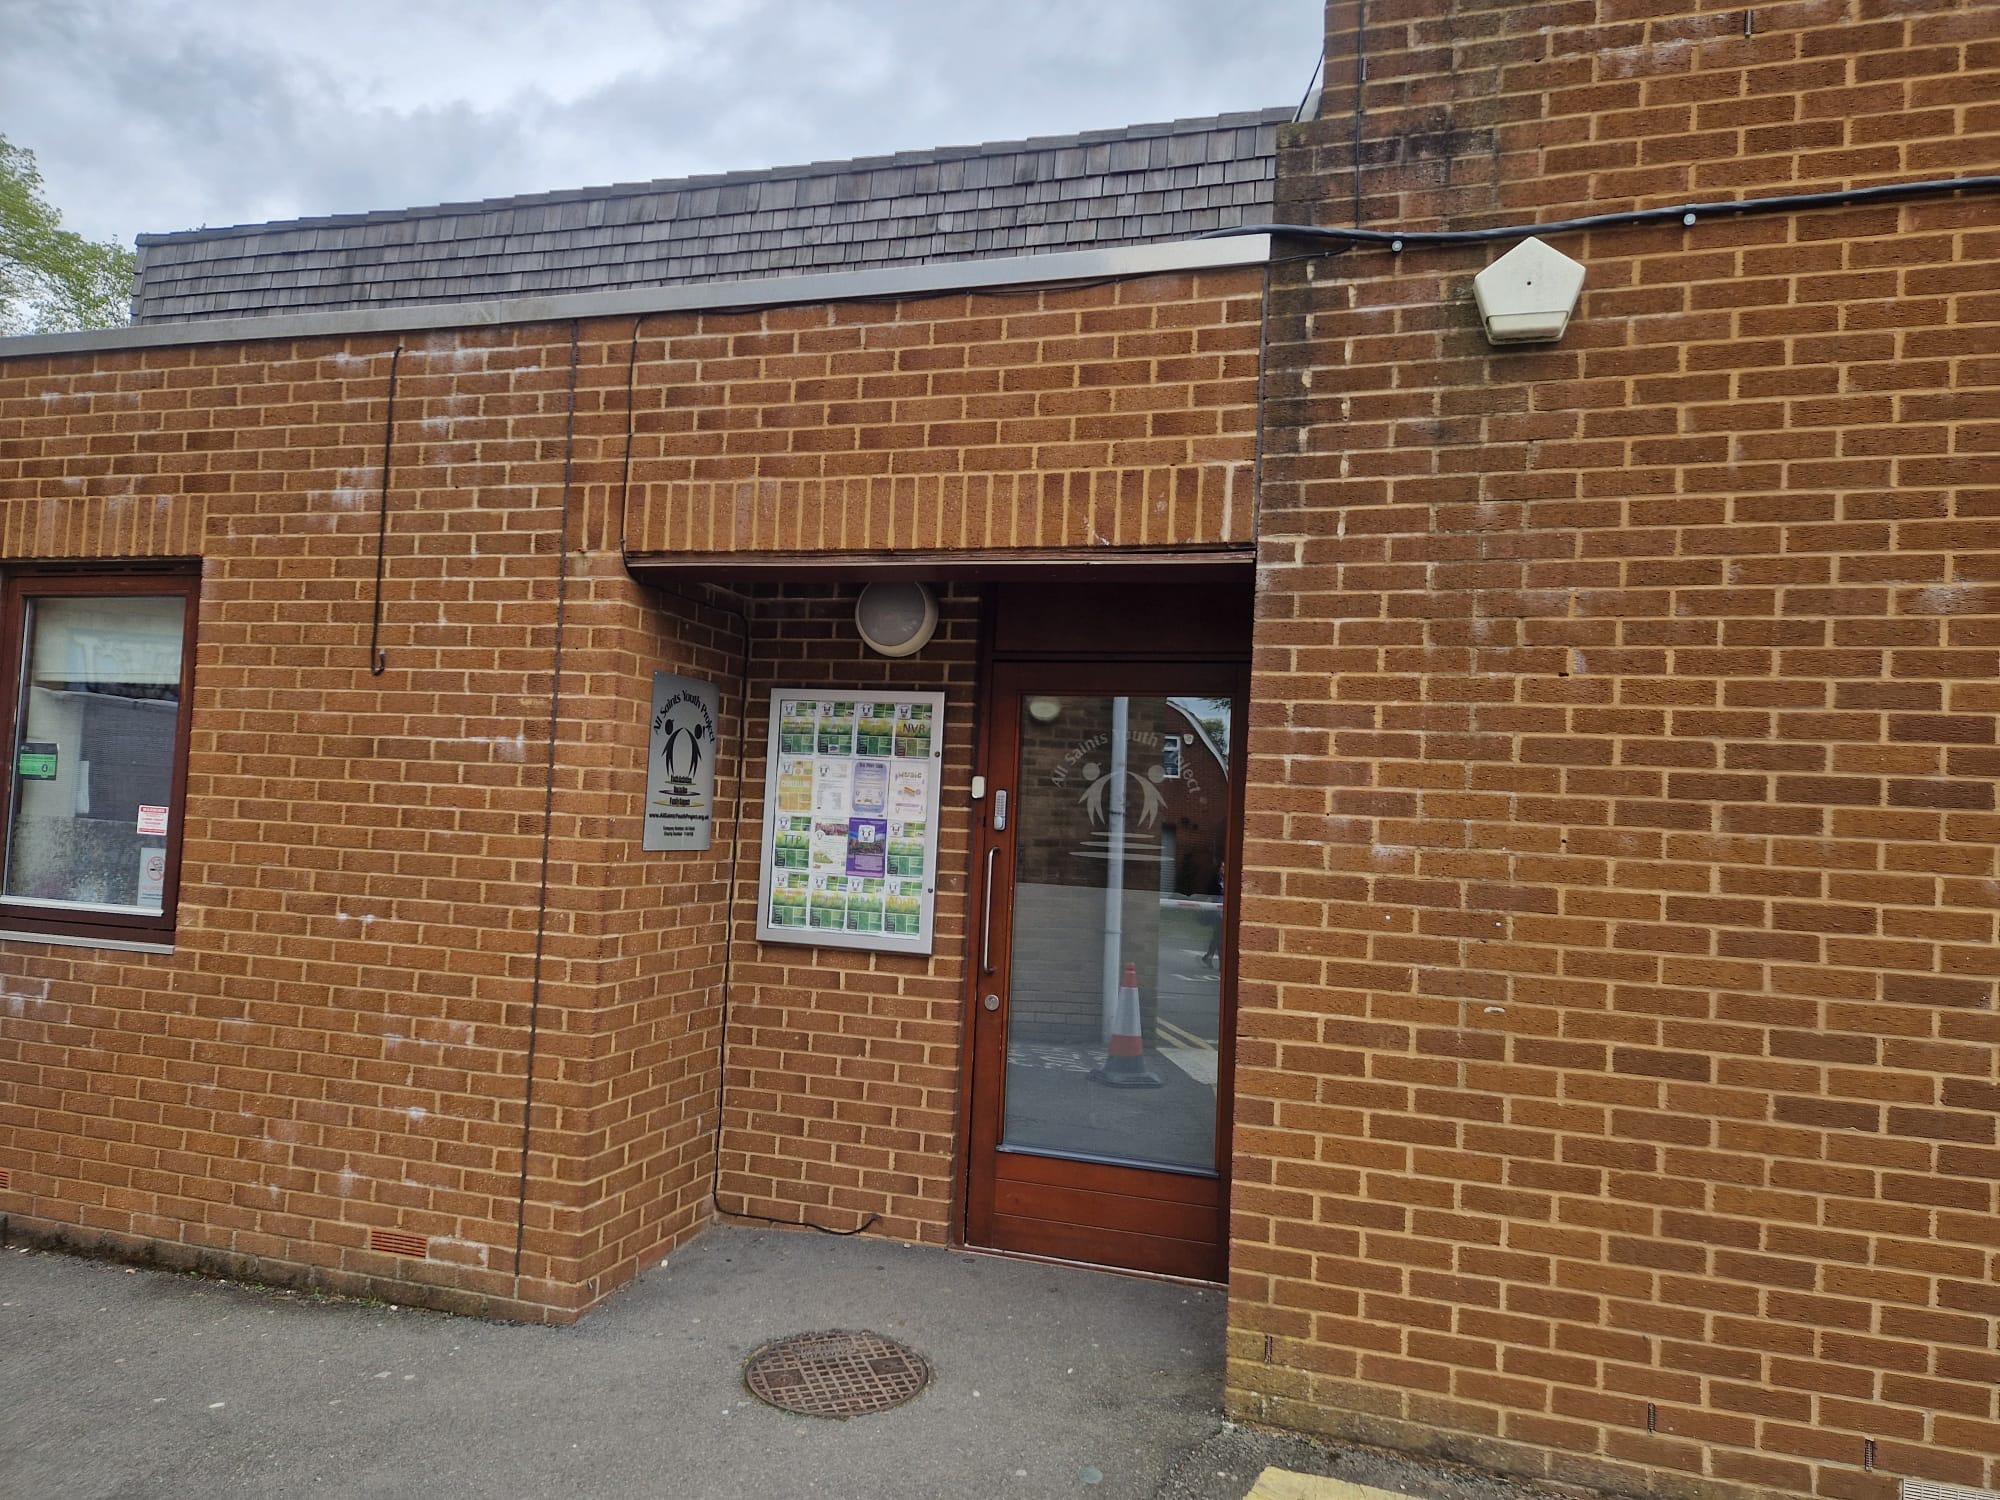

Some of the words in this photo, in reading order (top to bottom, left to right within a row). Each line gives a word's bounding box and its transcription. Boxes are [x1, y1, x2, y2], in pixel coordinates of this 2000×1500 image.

[654, 716, 662, 736] All
[660, 693, 681, 718] Saints
[682, 690, 700, 709] Youth
[701, 704, 715, 744] Project
[903, 723, 926, 733] NVR
[1051, 764, 1068, 789] All
[1065, 732, 1108, 765] Saints
[784, 834, 802, 844] TTP
